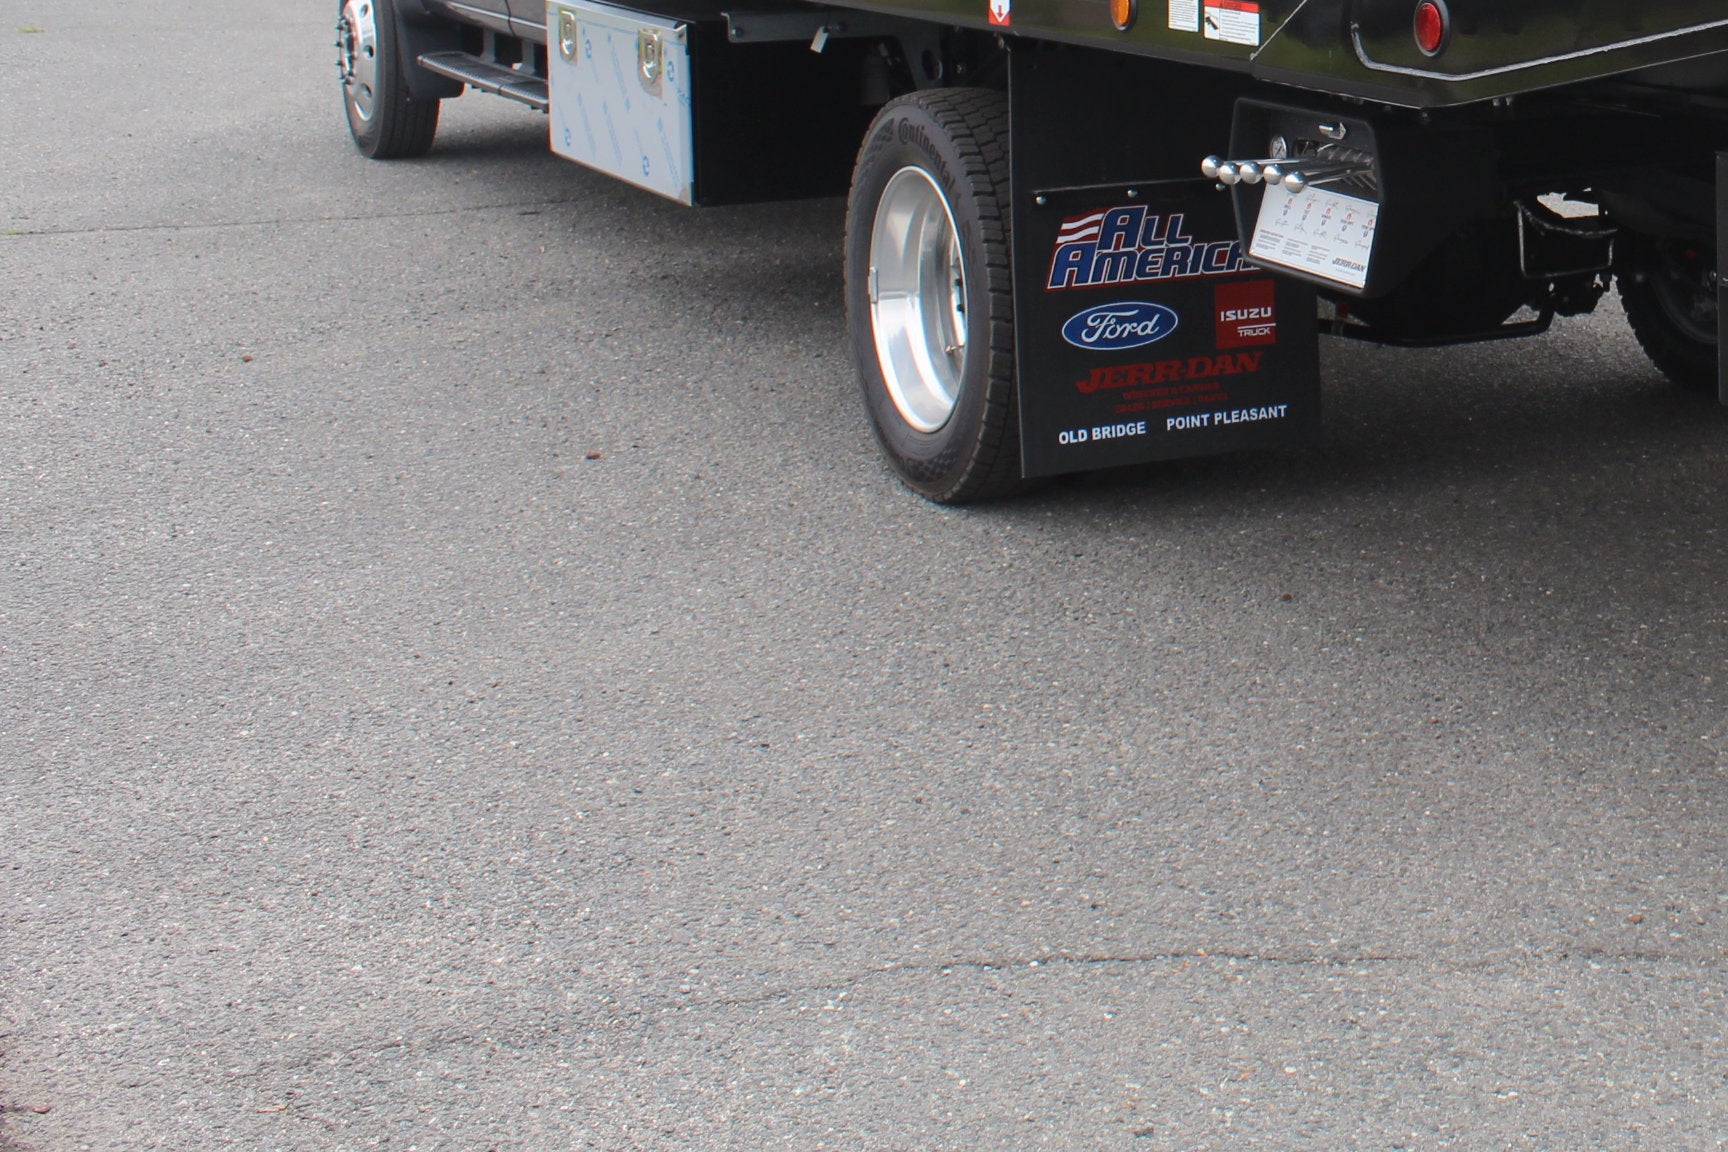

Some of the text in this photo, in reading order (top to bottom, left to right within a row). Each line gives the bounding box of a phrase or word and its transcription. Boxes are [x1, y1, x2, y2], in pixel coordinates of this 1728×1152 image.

[1097, 205, 1193, 253] ALL
[1081, 308, 1161, 344] Ford
[1220, 306, 1273, 322] ISUZU
[1237, 327, 1271, 338] TRUCK
[1166, 404, 1288, 432] POINT PLEASANT
[1058, 421, 1147, 445] OLD BRIDGE
